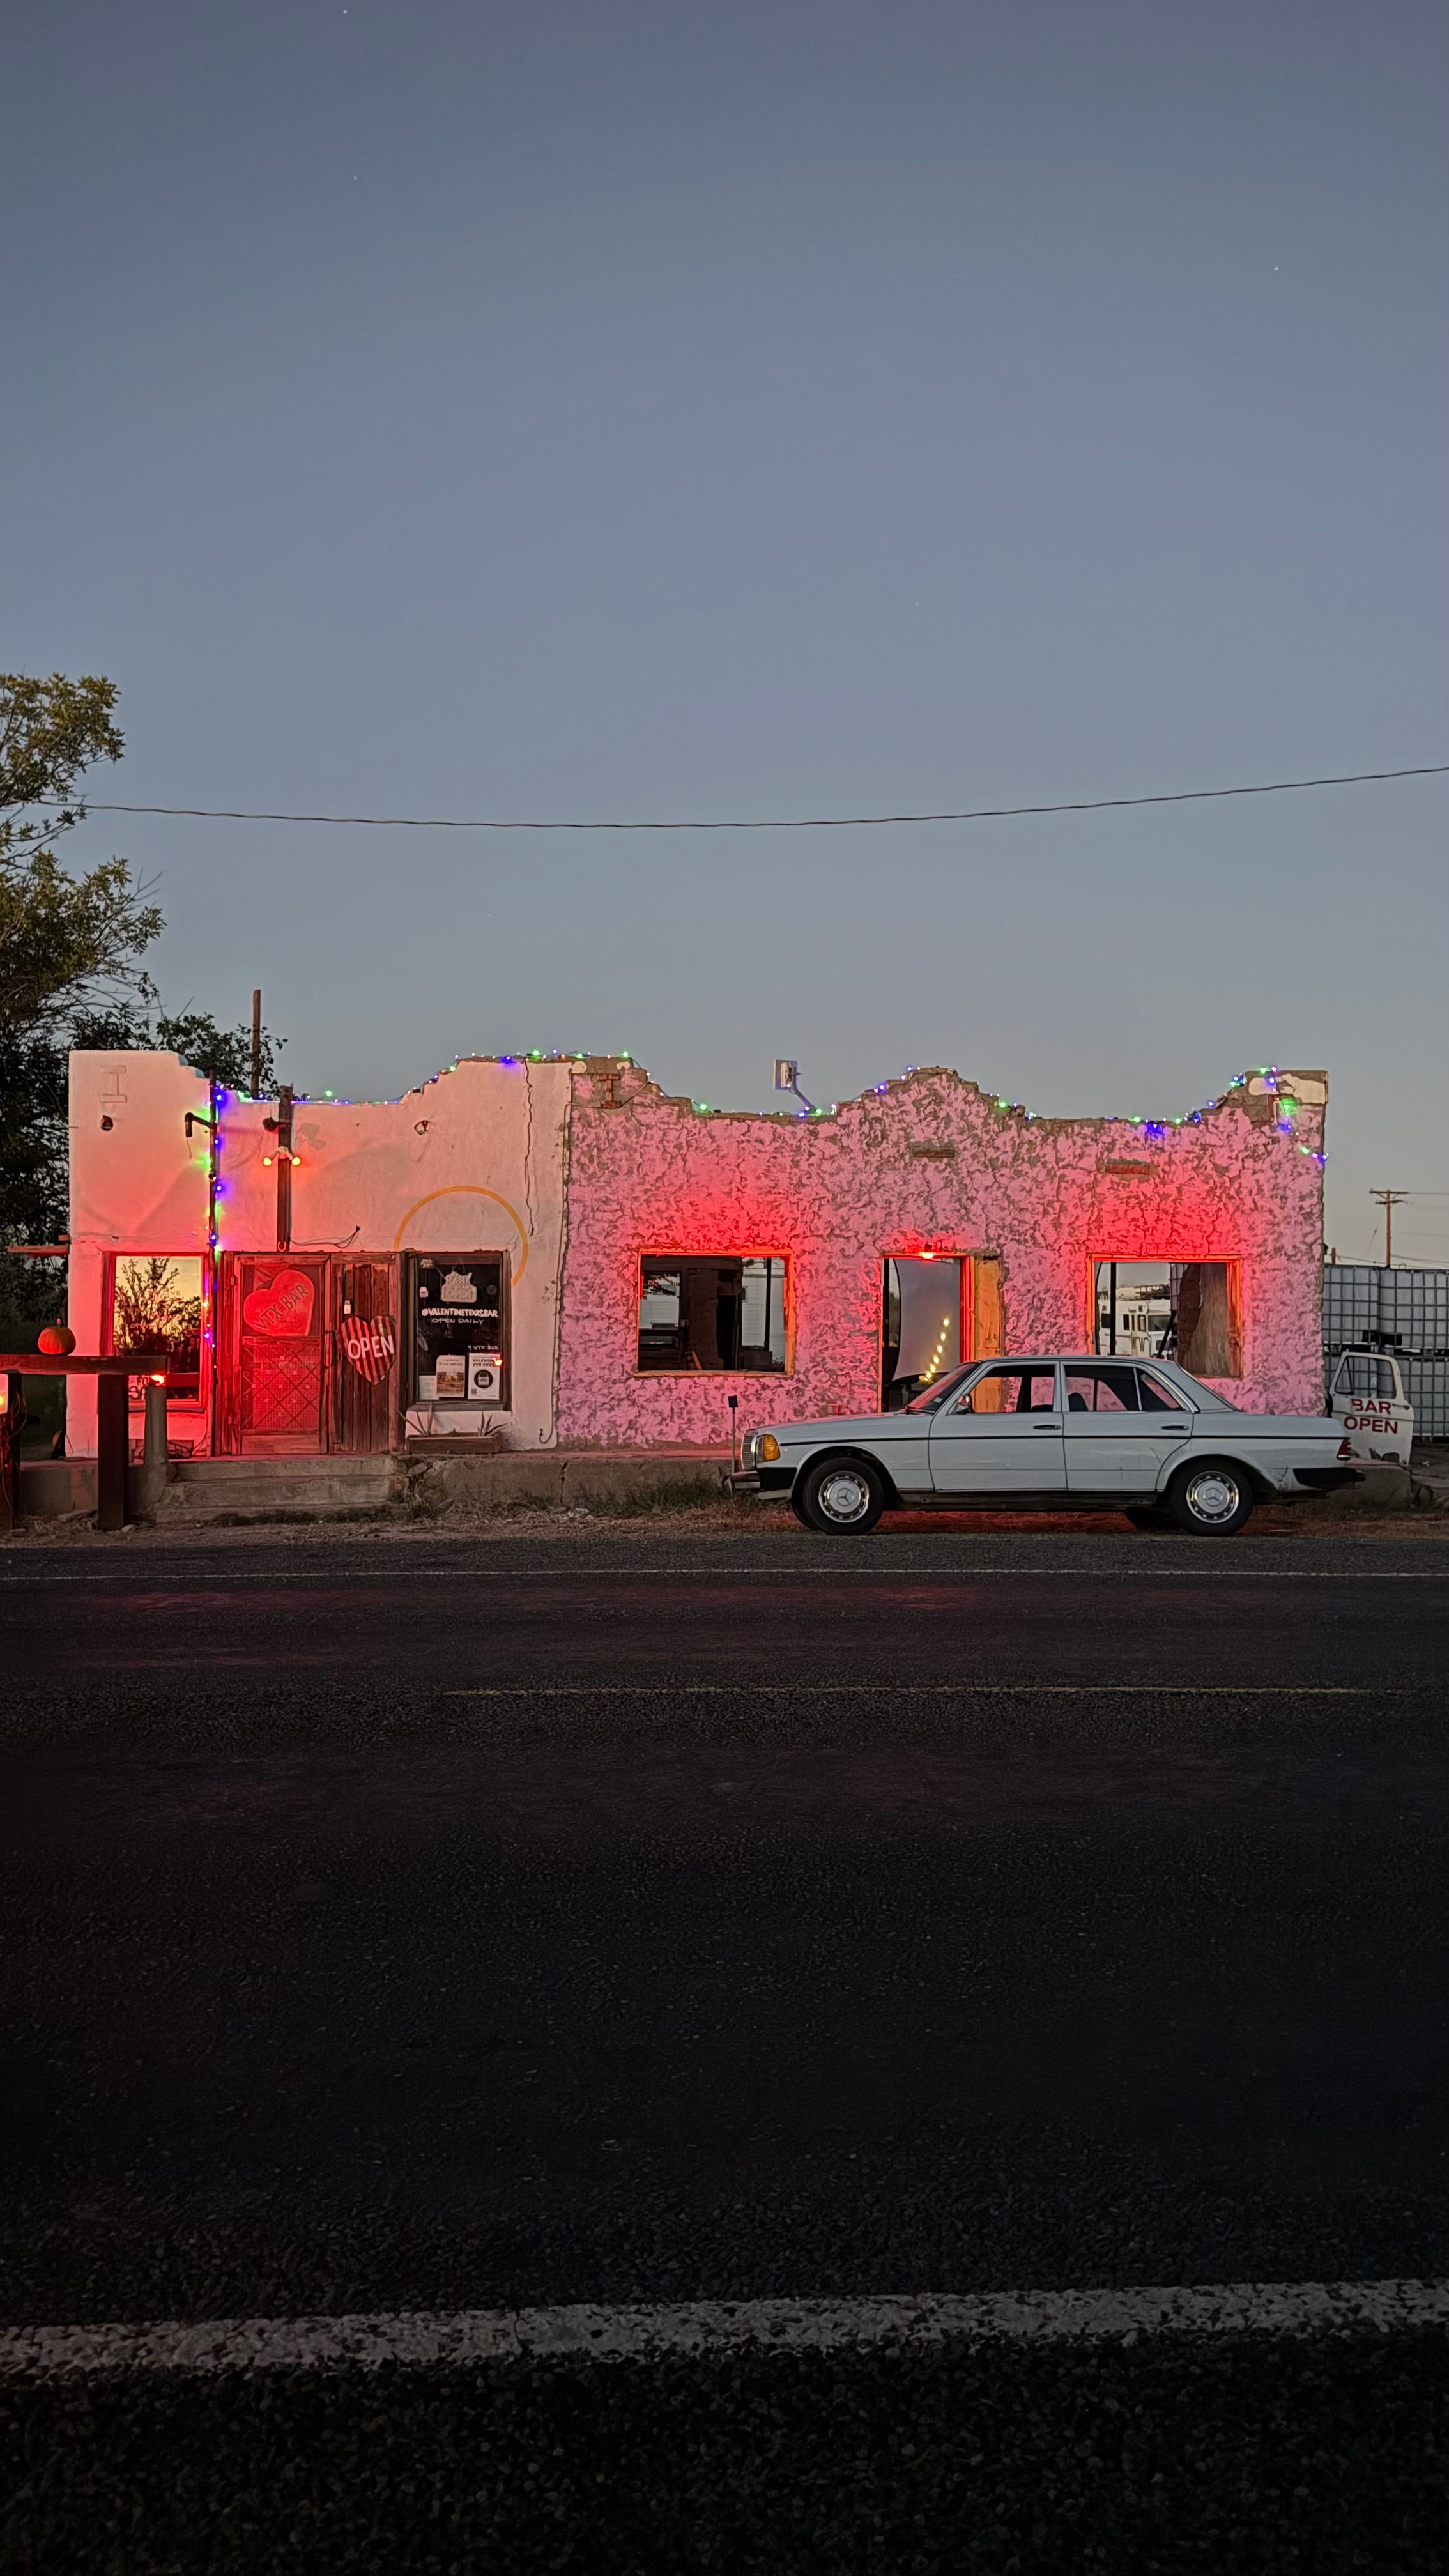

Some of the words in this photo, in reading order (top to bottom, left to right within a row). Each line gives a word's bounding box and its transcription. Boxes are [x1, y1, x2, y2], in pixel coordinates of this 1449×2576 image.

[254, 1304, 283, 1330] VTX
[280, 1284, 308, 1310] BAR
[422, 1308, 498, 1318] @VALENTINETEXASBAR
[348, 1335, 394, 1360] OPEN
[1351, 1399, 1391, 1414] BAR
[1344, 1416, 1398, 1434] OPEN
